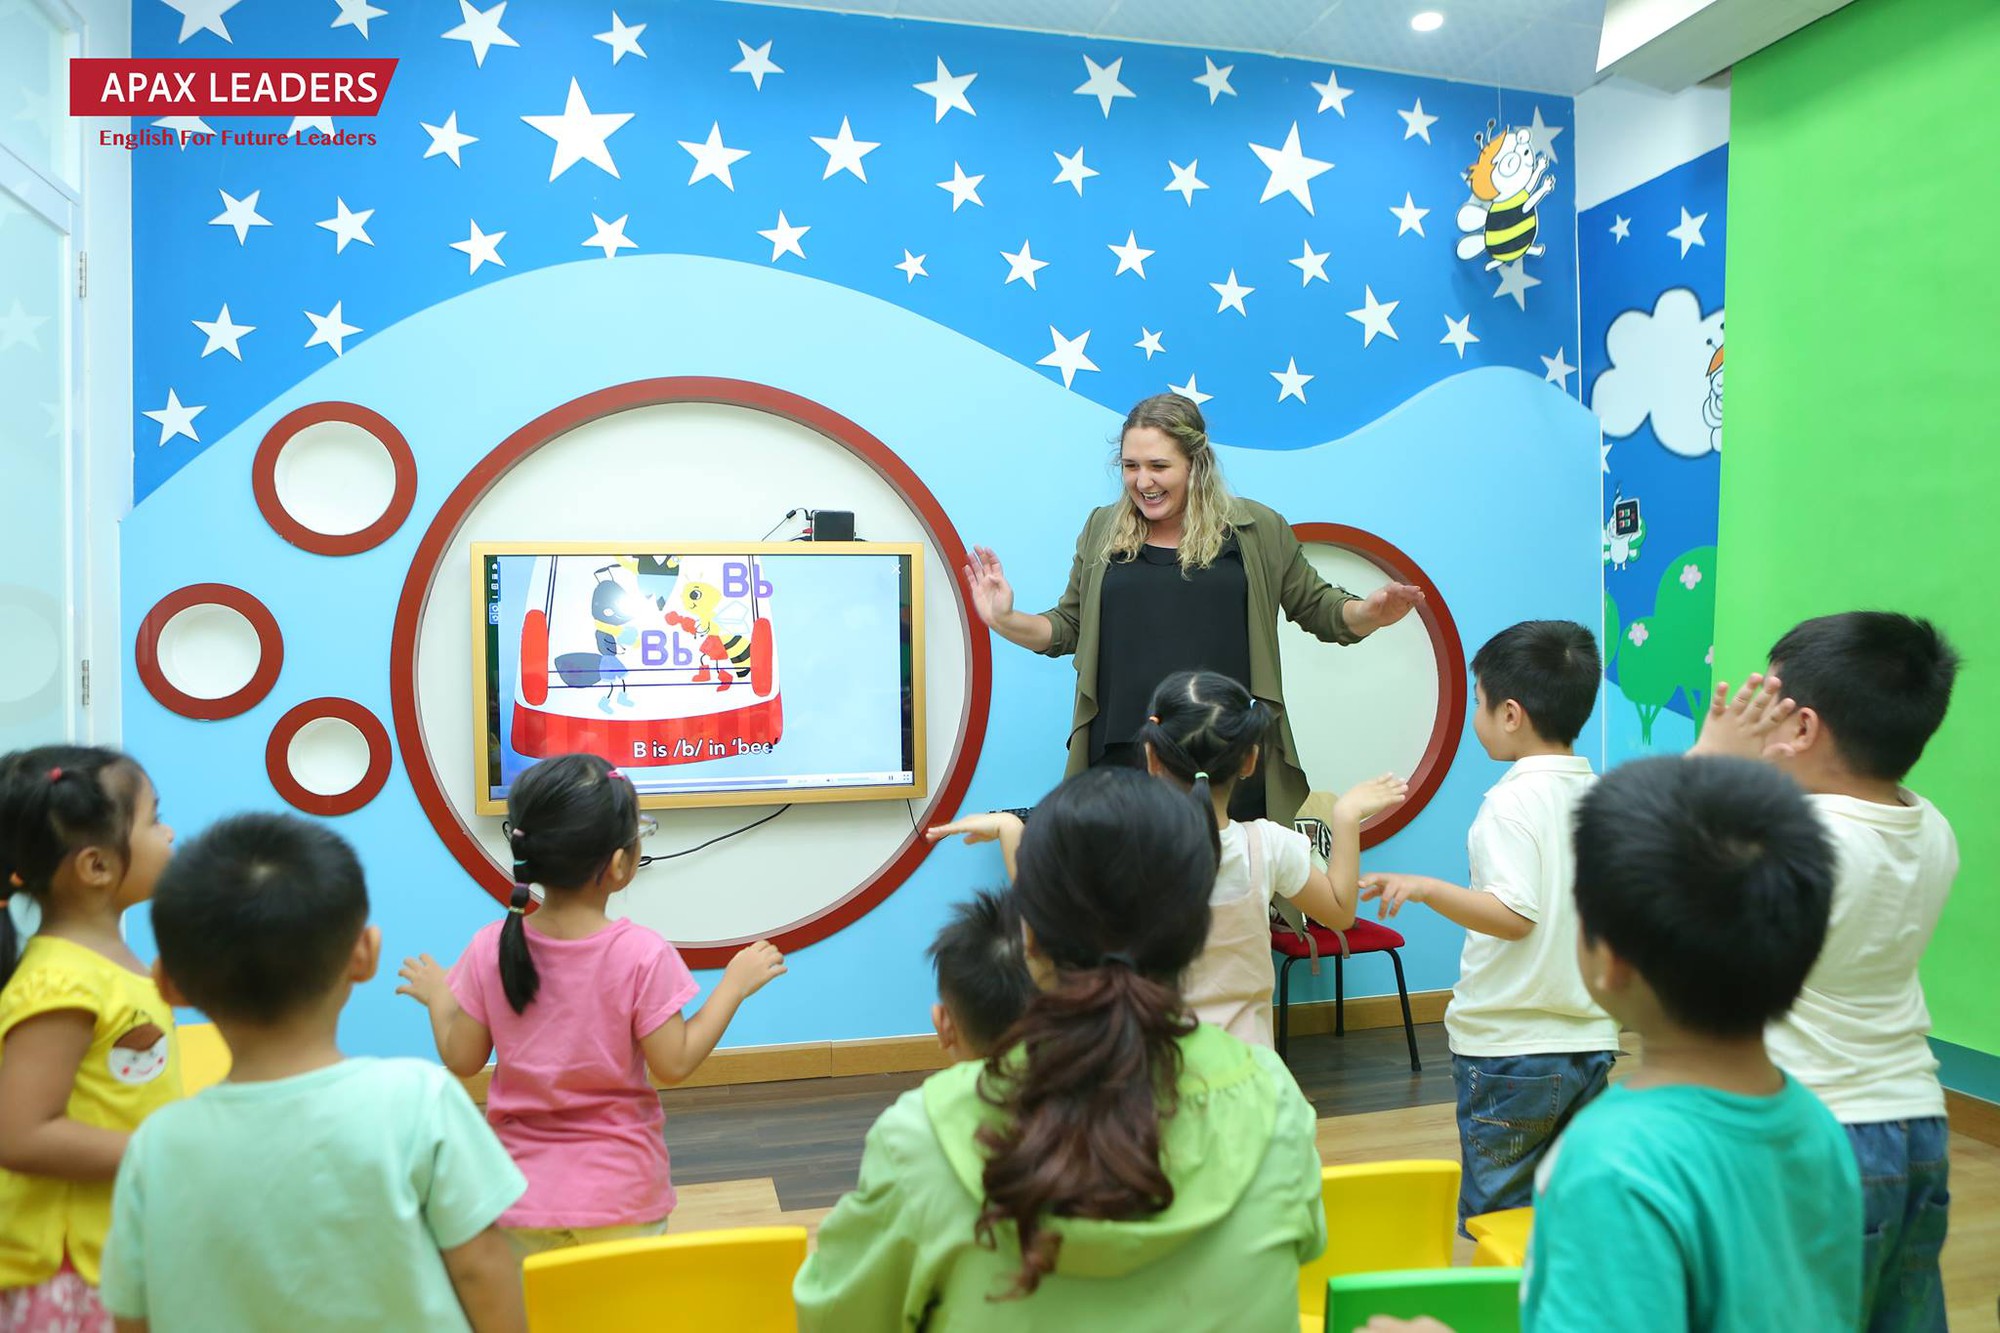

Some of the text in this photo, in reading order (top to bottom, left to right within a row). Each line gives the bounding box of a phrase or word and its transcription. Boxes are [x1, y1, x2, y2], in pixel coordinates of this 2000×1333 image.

[722, 562, 773, 598] Bb
[641, 630, 693, 666] Bb
[633, 741, 647, 758] B
[652, 741, 668, 758] is
[673, 739, 703, 757] /b/
[709, 739, 726, 756] in
